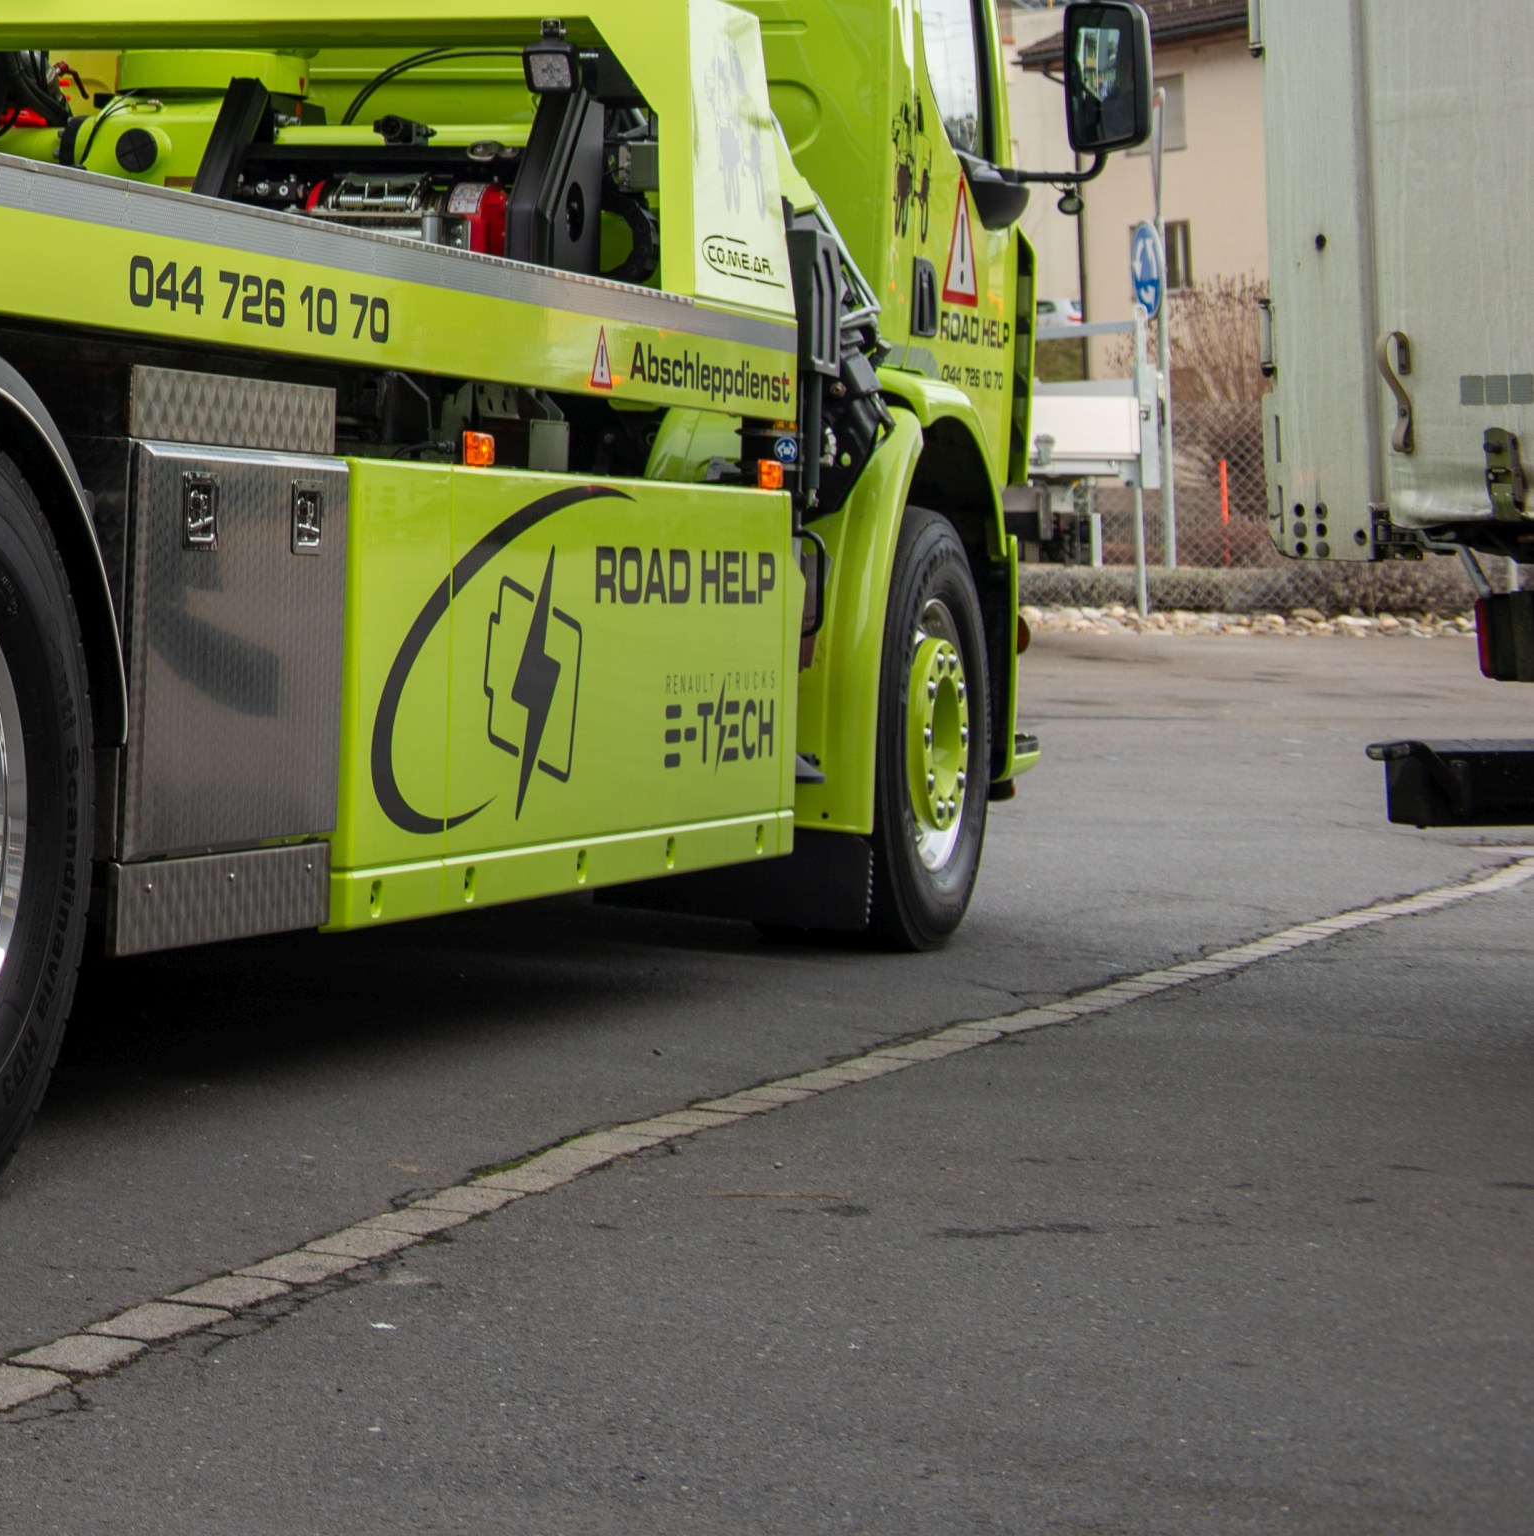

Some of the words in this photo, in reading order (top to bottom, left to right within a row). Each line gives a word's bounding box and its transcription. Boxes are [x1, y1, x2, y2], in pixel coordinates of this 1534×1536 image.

[129, 255, 204, 316] 044
[219, 270, 285, 328] 726
[299, 285, 338, 337] 10
[350, 293, 390, 344] 70
[940, 311, 979, 345] ROAD
[982, 318, 1010, 350] HELP
[630, 341, 791, 404] Abschleppdienst
[941, 364, 962, 385] 044
[965, 367, 981, 388] 726
[983, 370, 992, 389] 10
[994, 371, 1004, 391] 70
[595, 546, 691, 604] ROAD
[701, 550, 776, 604] HELP
[666, 672, 714, 695] RENAULT
[727, 670, 775, 691] TRUCKS
[664, 698, 775, 769] E-TECH
[36, 745, 80, 1020] Scandinavia
